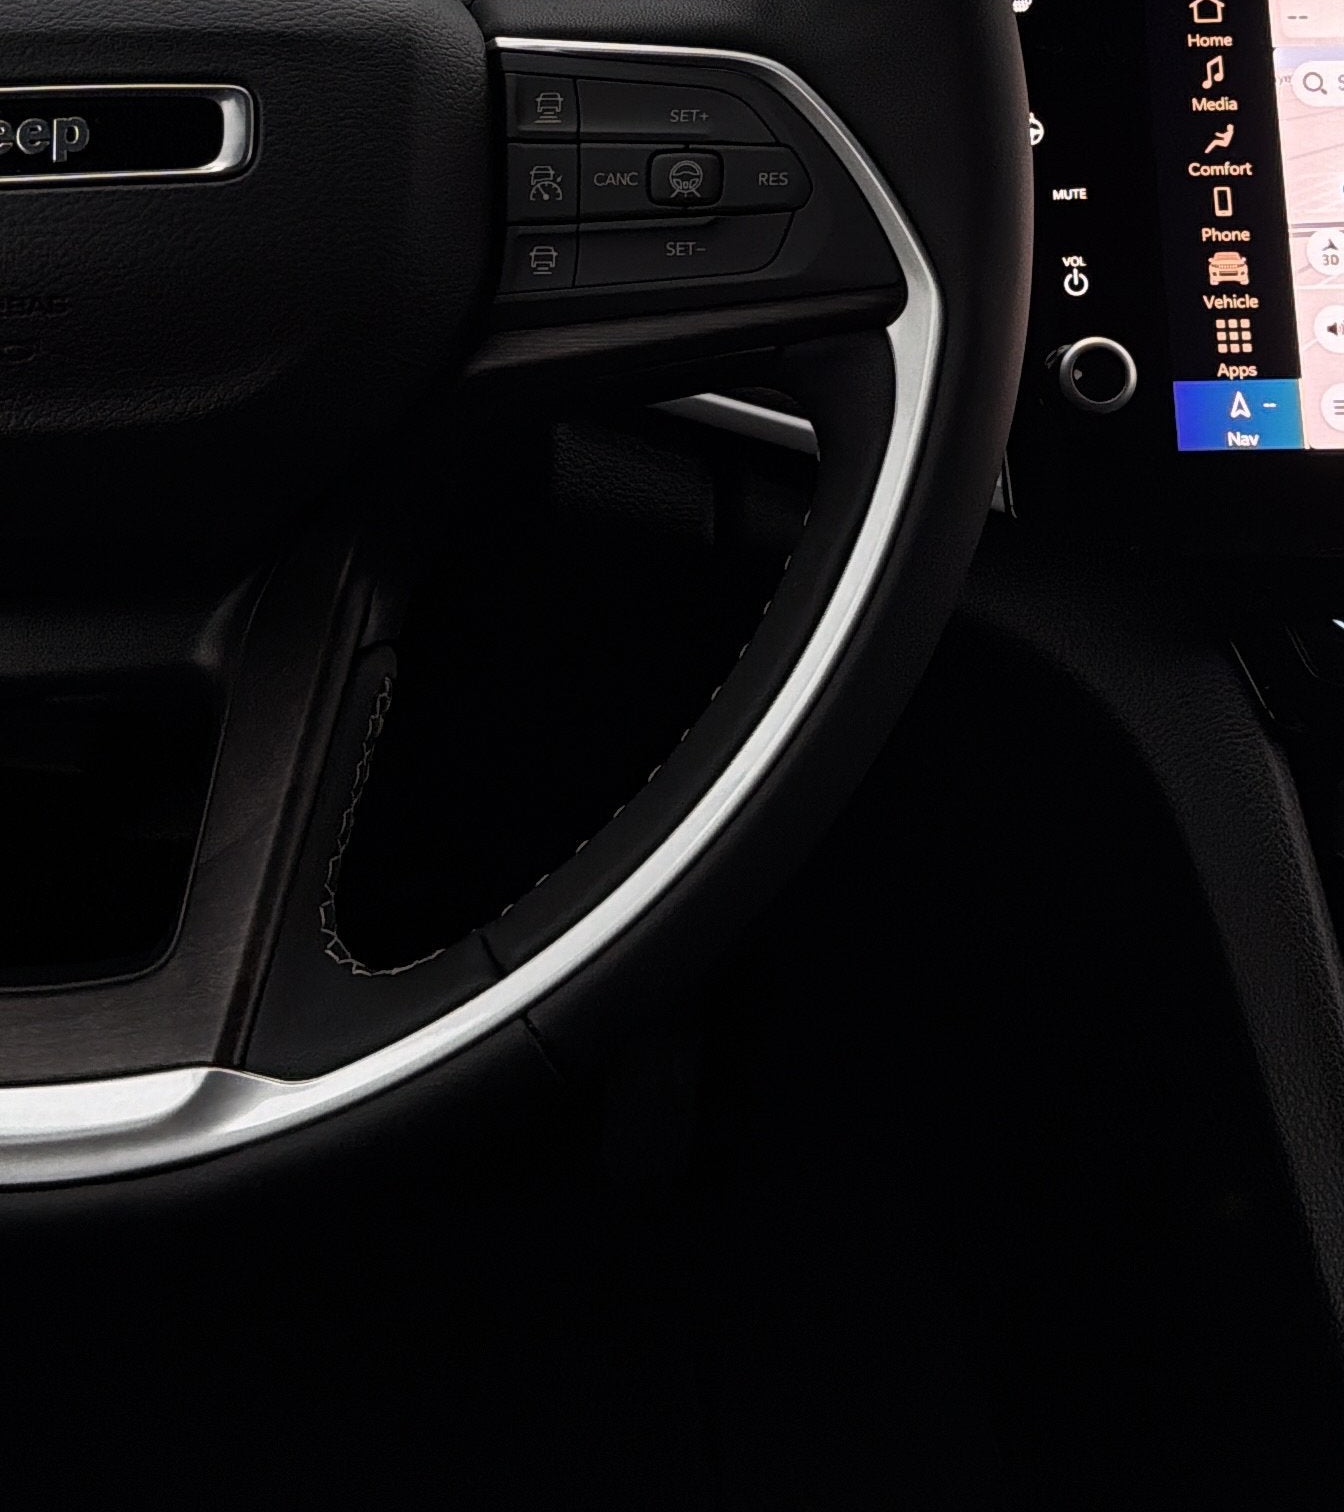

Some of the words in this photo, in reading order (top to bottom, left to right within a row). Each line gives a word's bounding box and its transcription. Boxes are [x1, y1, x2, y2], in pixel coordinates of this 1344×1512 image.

[1187, 32, 1233, 48] Home
[1191, 96, 1238, 112] Media
[670, 108, 709, 124] SET+
[1188, 161, 1253, 178] Comfort
[593, 171, 639, 187] CANC
[758, 171, 789, 186] RES
[1052, 188, 1088, 201] MUTE
[1201, 227, 1250, 244] Phone
[1062, 256, 1087, 268] VOL
[1322, 254, 1341, 268] 3D
[1203, 294, 1260, 310] Vehicle
[1217, 363, 1258, 379] Apps
[1227, 432, 1260, 448] Nav
